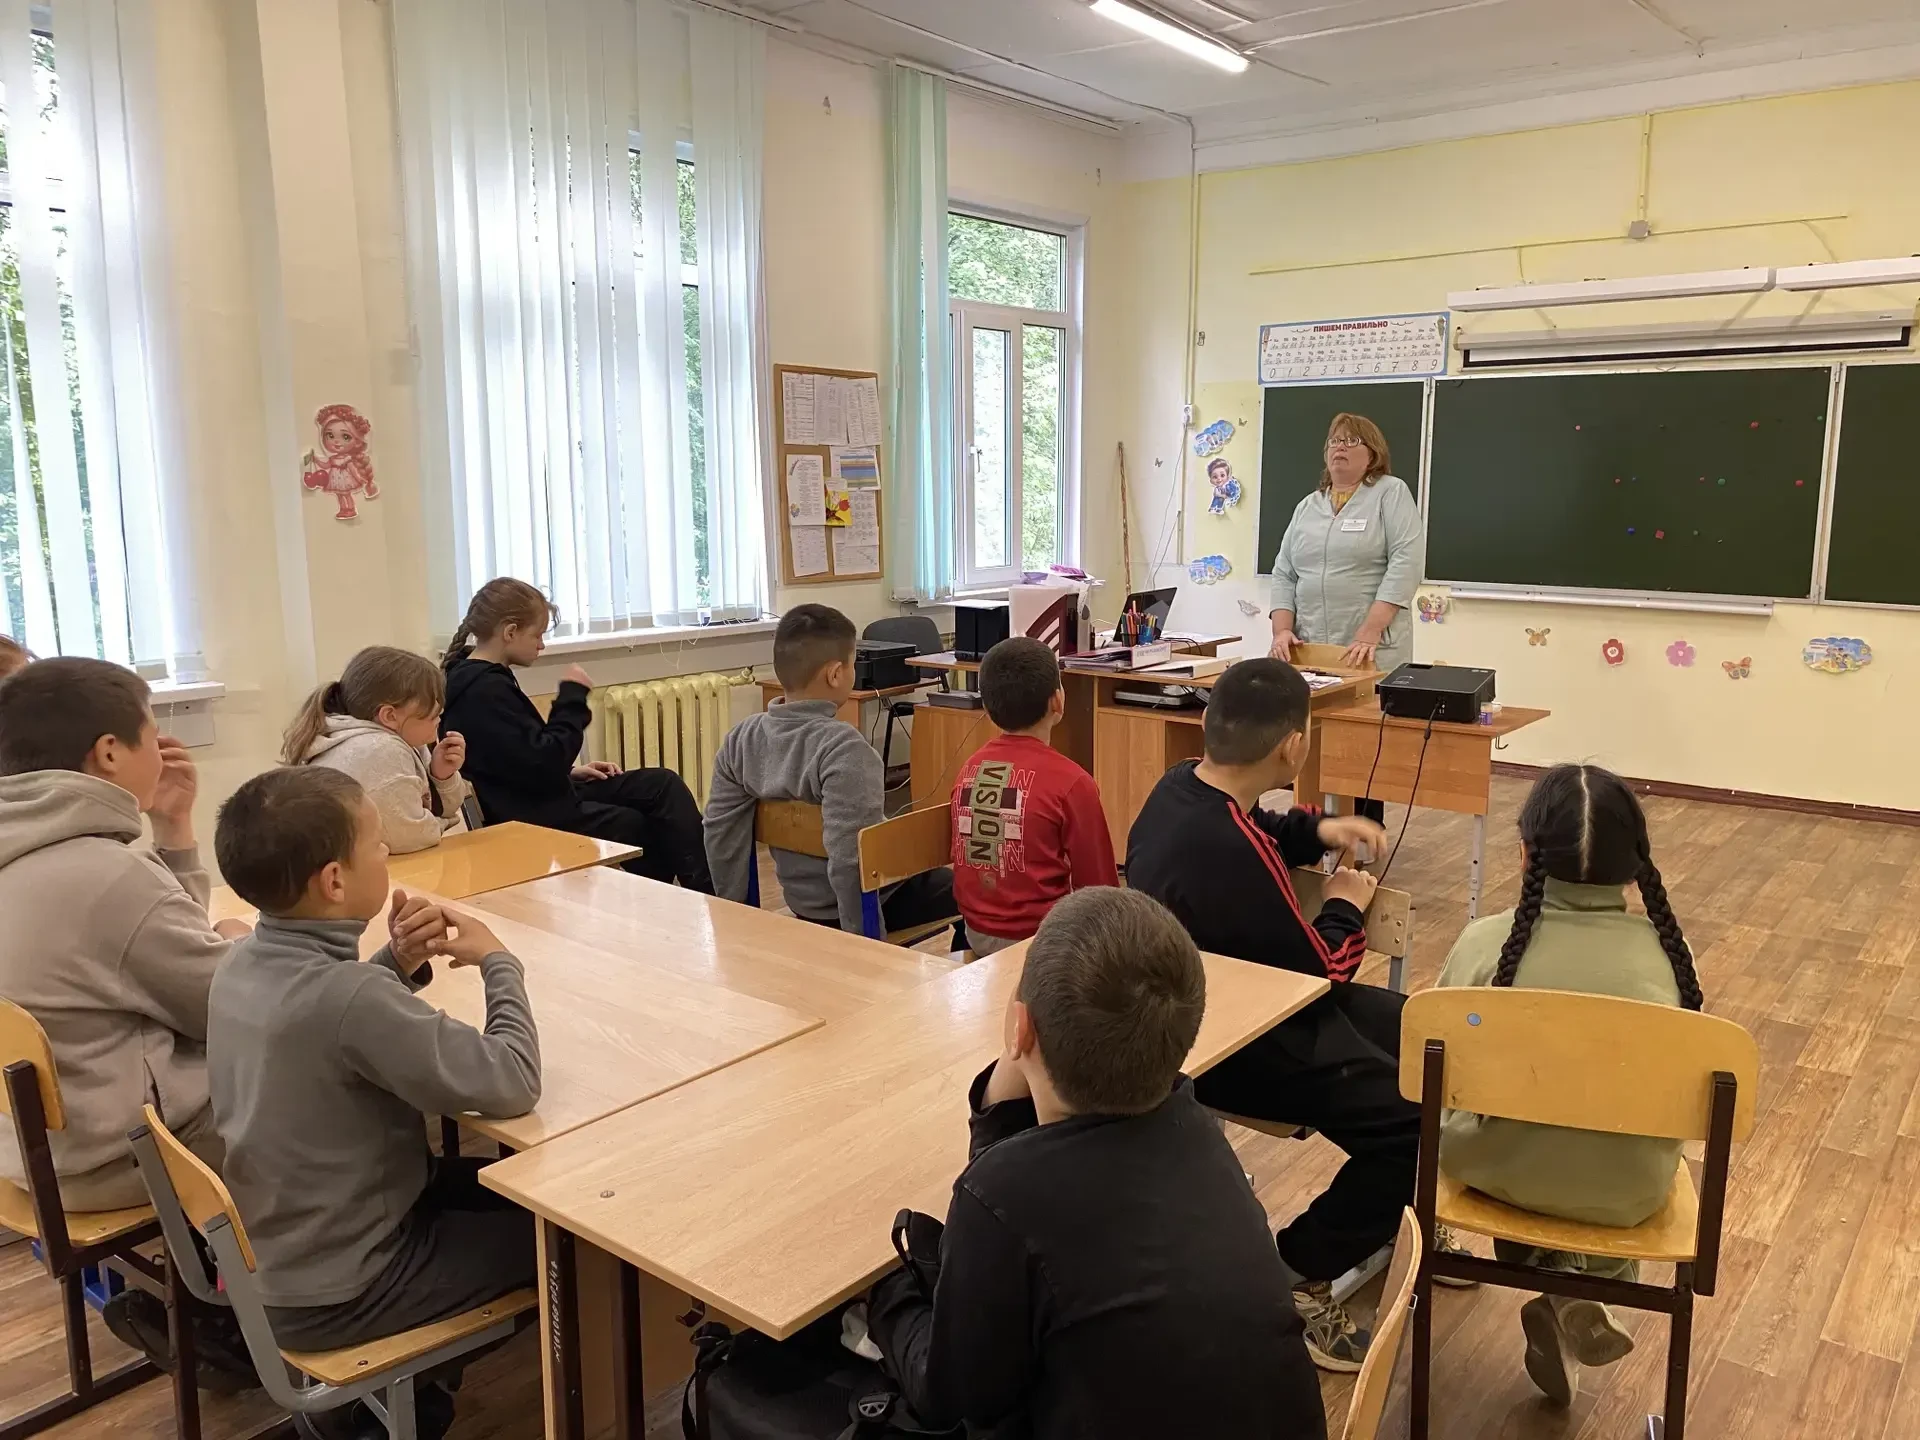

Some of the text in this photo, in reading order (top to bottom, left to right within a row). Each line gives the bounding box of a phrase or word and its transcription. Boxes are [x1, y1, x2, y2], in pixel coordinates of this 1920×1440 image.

[1313, 321, 1388, 332] ПИШЕМ ПРАВИЛЬНО
[1269, 359, 1437, 378] 0 1 2 3 4 5 6 7 8 9
[971, 766, 1007, 861] VISION
